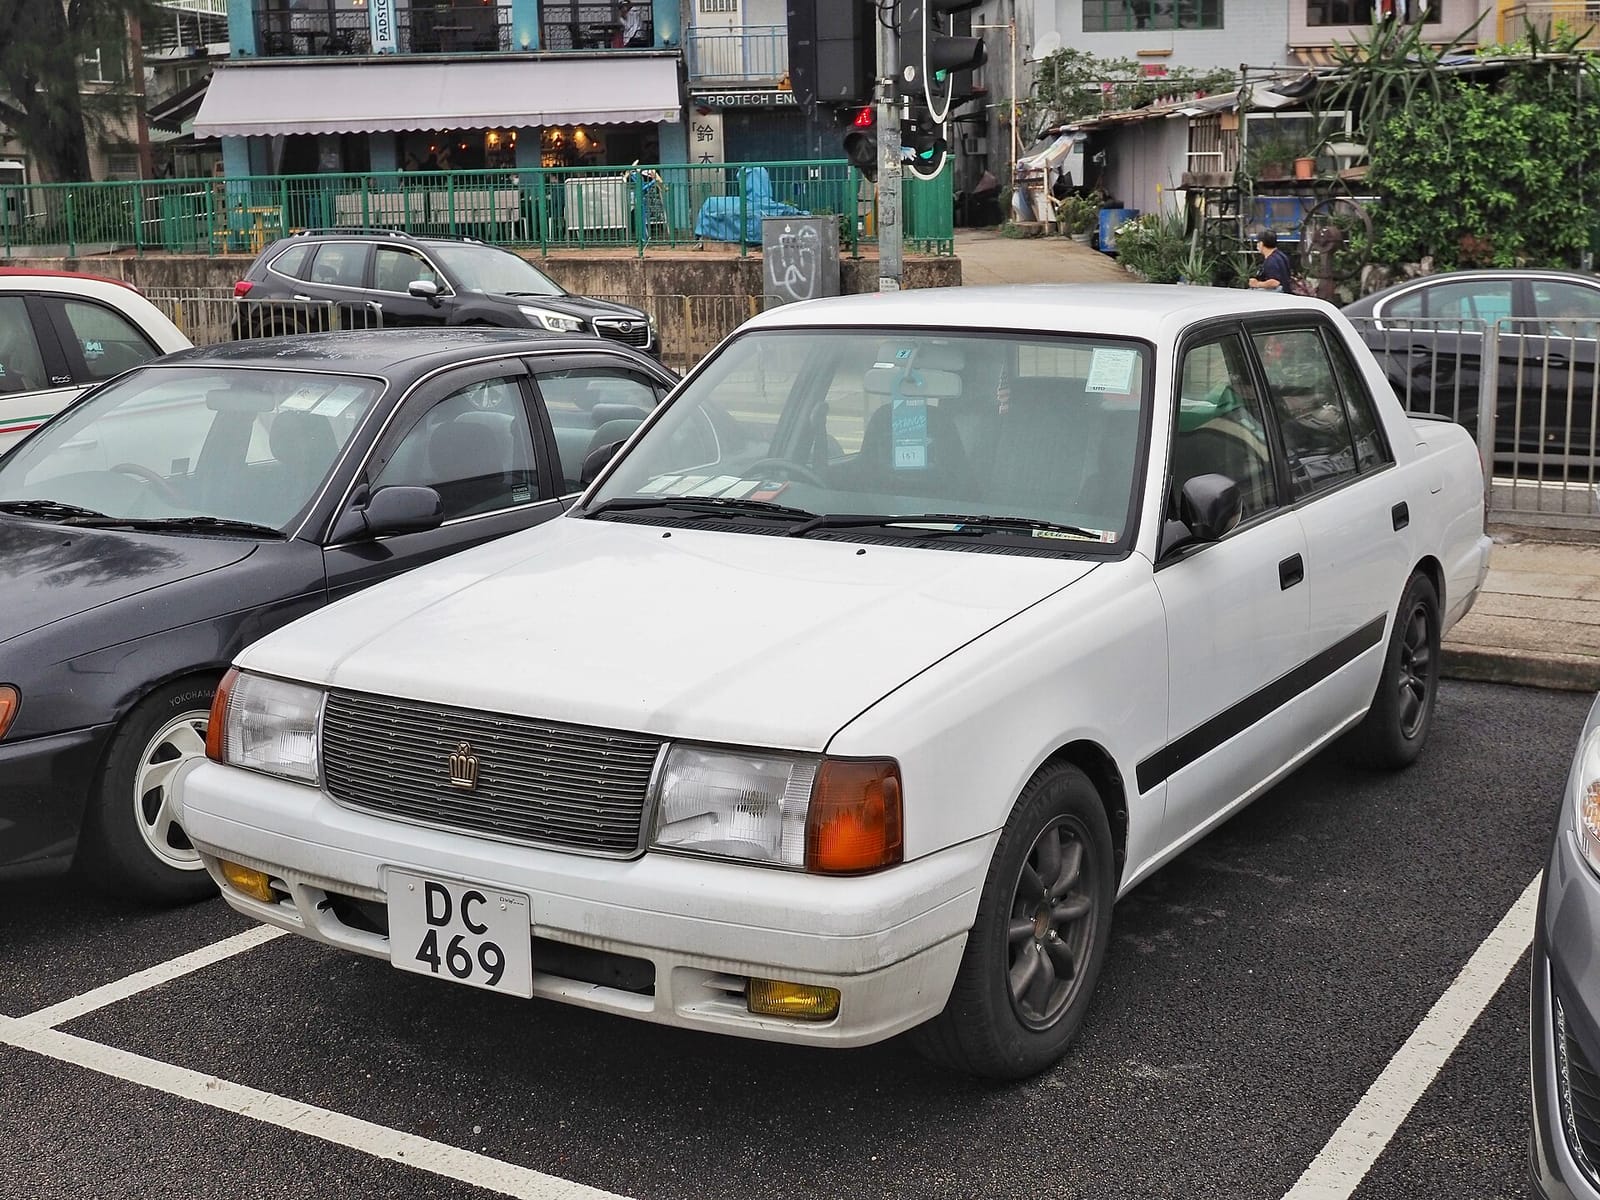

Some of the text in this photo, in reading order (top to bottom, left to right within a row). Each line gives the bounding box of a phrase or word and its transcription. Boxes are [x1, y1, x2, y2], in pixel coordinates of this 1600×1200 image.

[707, 94, 798, 105] PROTECH EN
[424, 880, 489, 936] DC
[415, 928, 506, 987] 469
